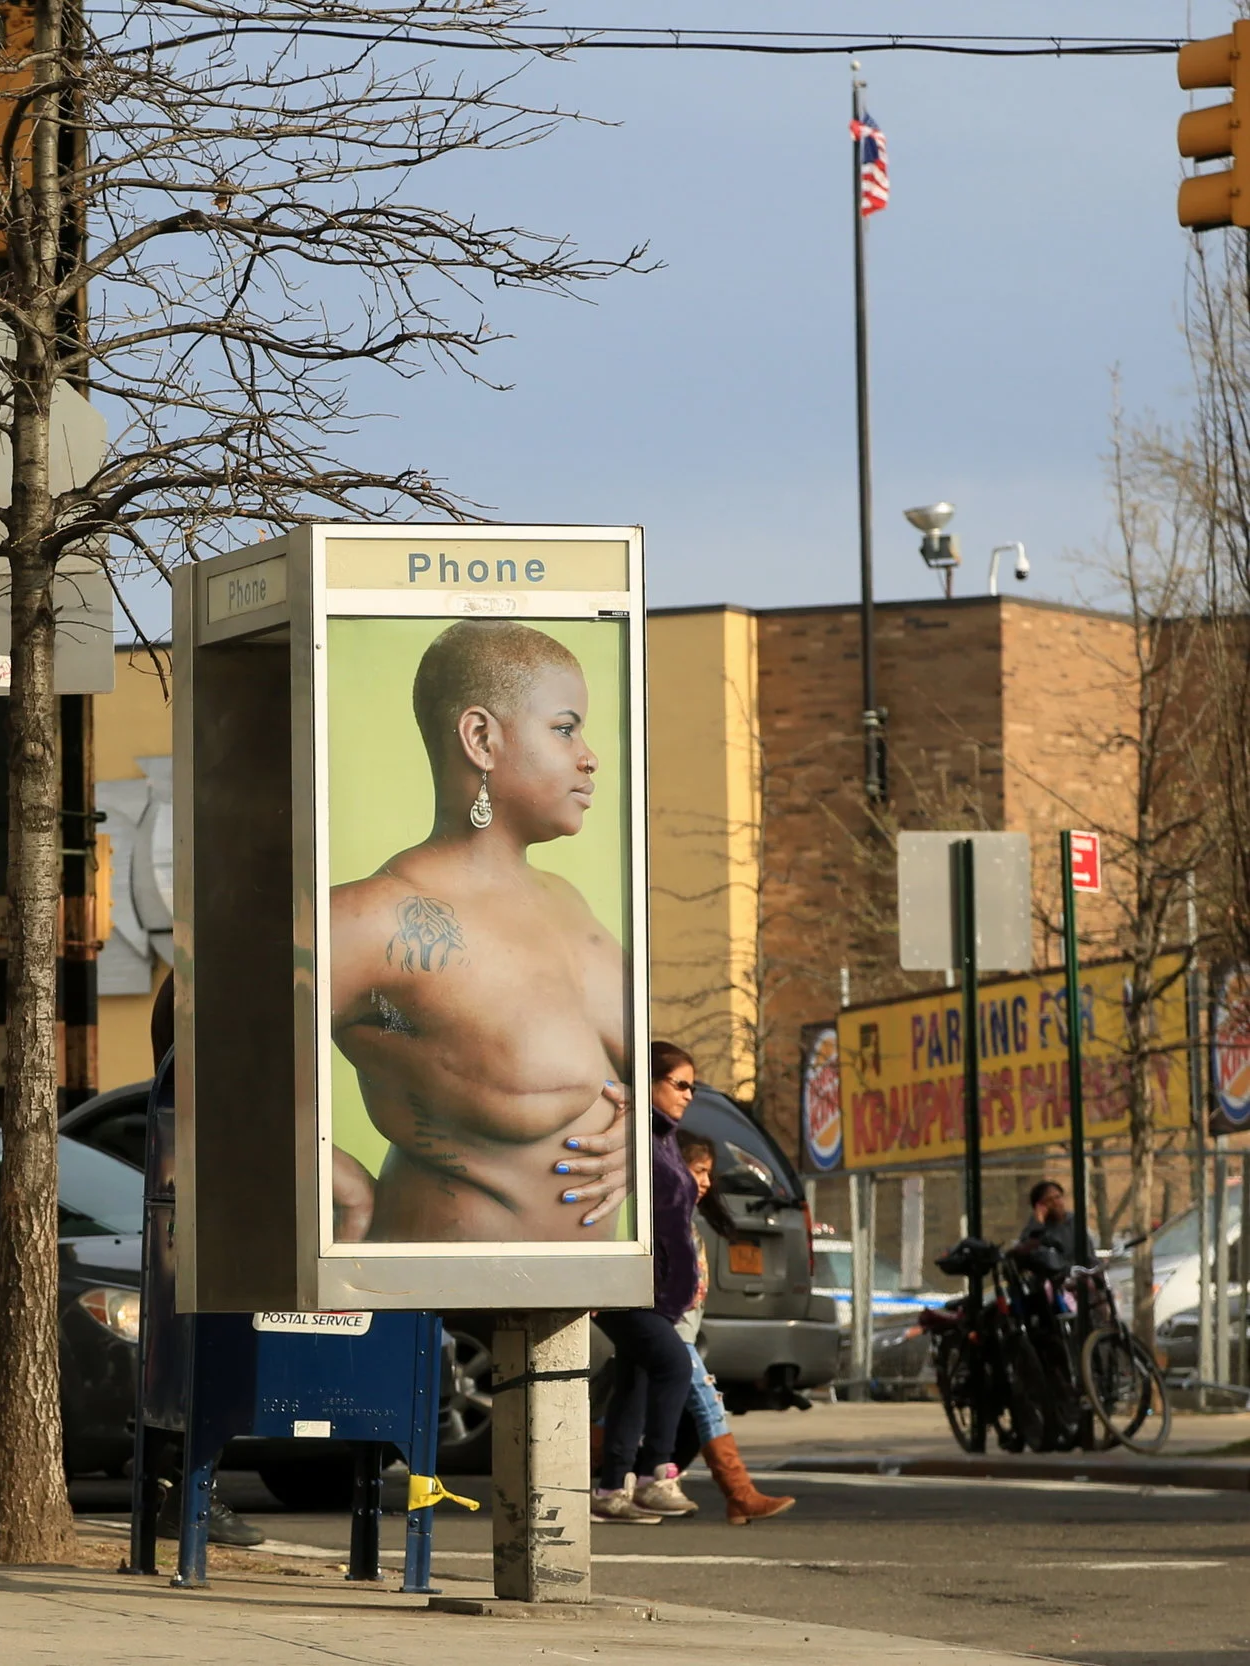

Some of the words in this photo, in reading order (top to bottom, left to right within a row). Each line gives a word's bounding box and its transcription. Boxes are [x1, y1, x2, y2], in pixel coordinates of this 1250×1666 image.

[408, 553, 546, 583] Phone
[228, 576, 267, 610] Phone
[911, 996, 1028, 1071] PARING
[261, 1312, 308, 1324] POSTAL
[311, 1314, 363, 1327] SERVICE
